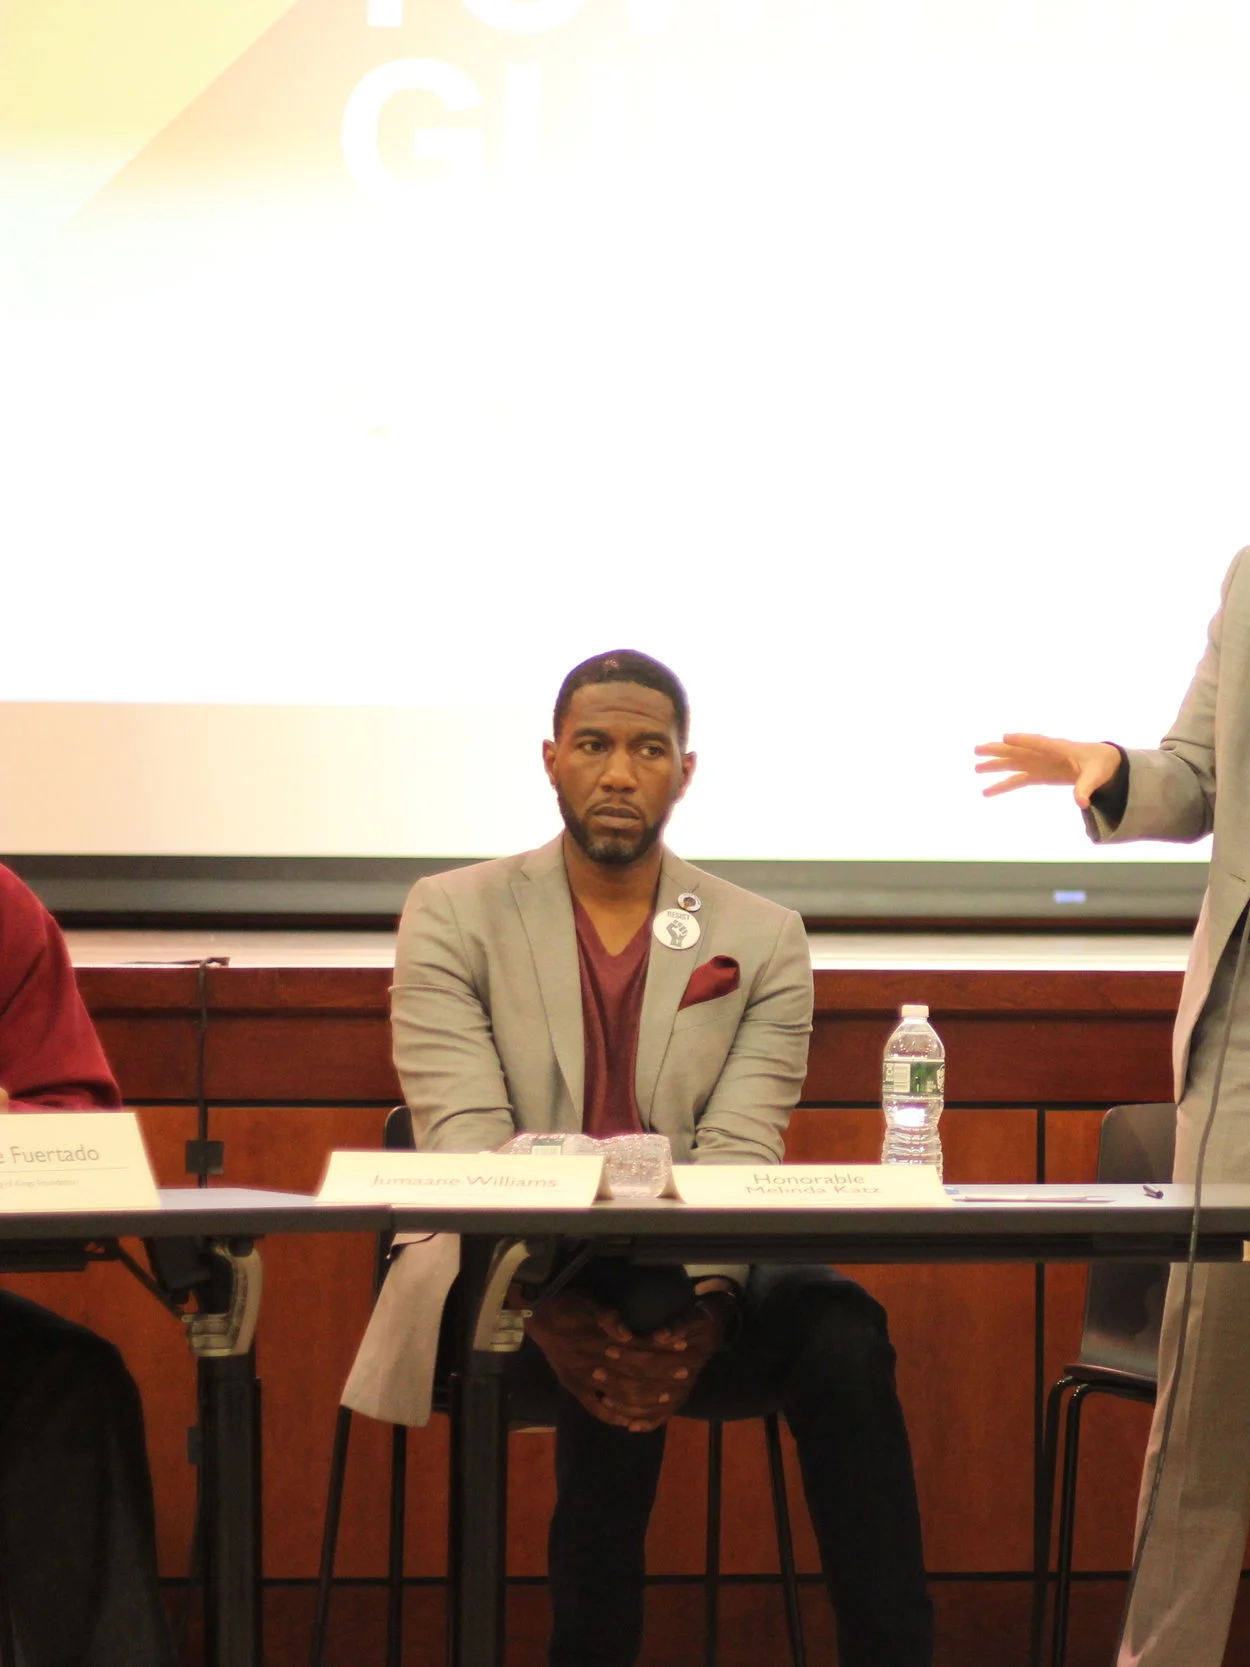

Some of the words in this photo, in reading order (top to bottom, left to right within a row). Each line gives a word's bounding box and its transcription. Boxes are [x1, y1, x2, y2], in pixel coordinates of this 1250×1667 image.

[10, 1144, 100, 1164] Fuertado
[371, 1174, 461, 1187] Jumaane
[466, 1175, 558, 1188] Williams
[753, 1173, 865, 1185] Honorable
[745, 1186, 828, 1195] Melinda
[834, 1186, 881, 1195] Katz
